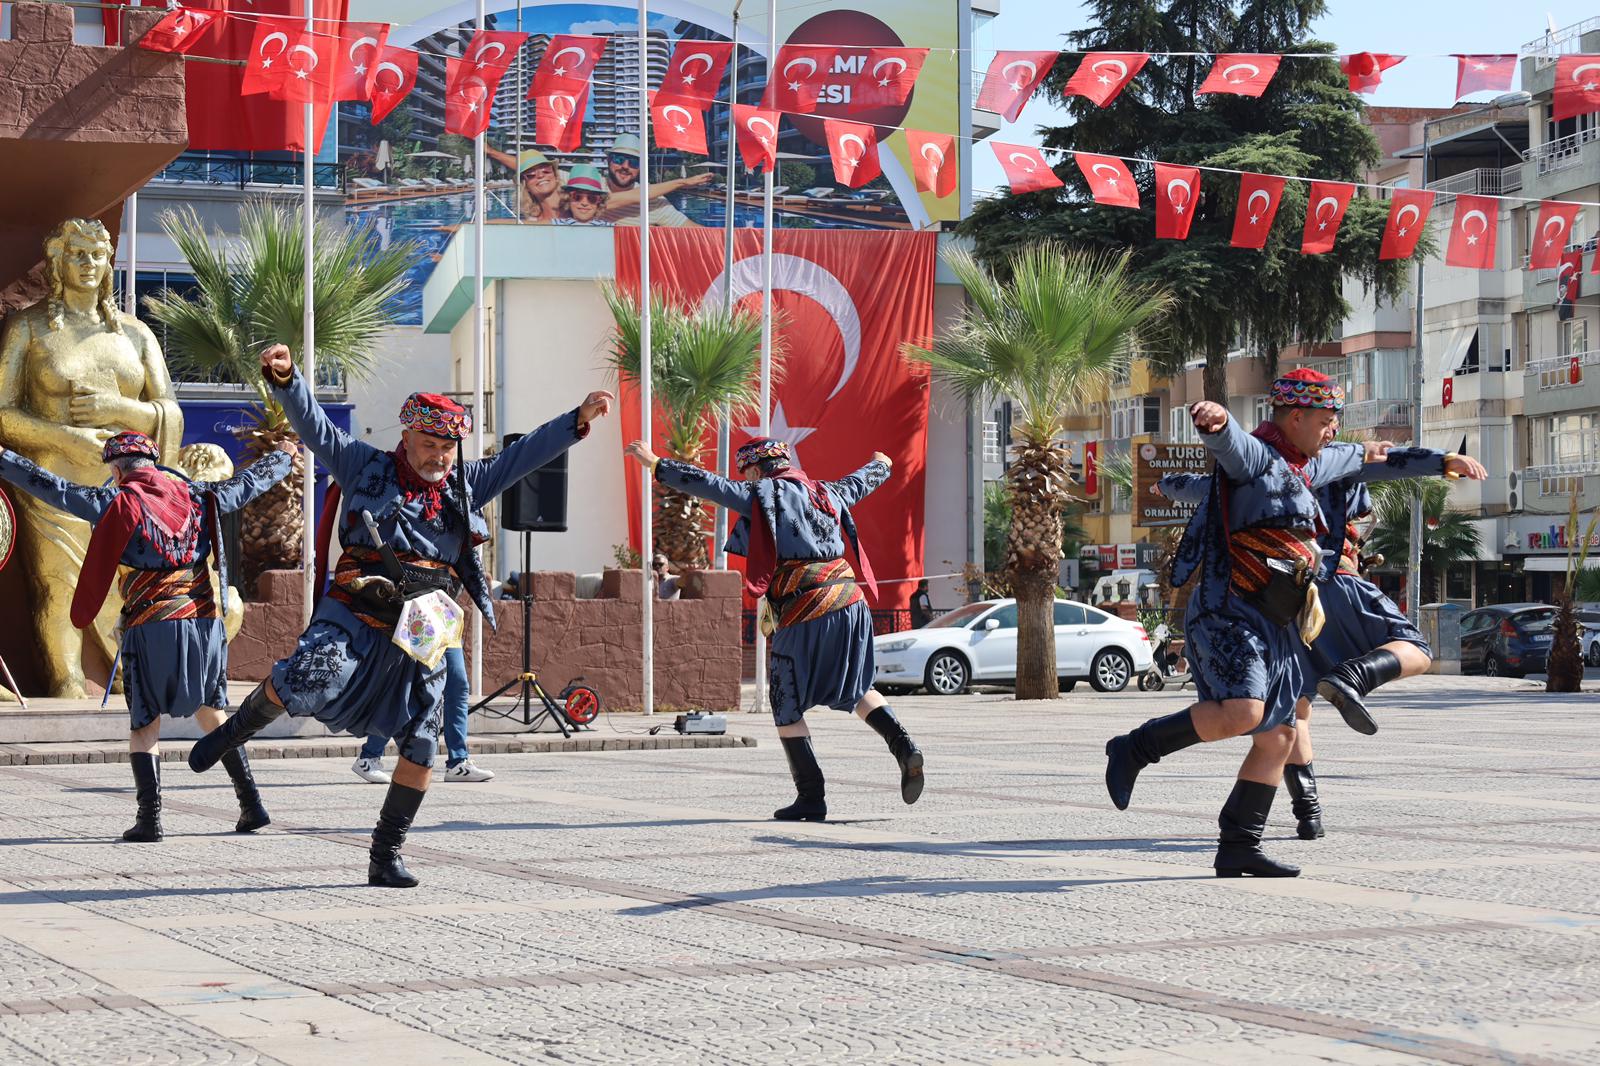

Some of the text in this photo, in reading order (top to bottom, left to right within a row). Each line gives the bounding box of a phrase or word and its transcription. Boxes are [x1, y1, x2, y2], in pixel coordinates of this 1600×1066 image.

[1166, 446, 1207, 459] TURG
[1149, 459, 1207, 469] ORMAN İŞLE
[1144, 509, 1196, 519] ORMAN İŞL
